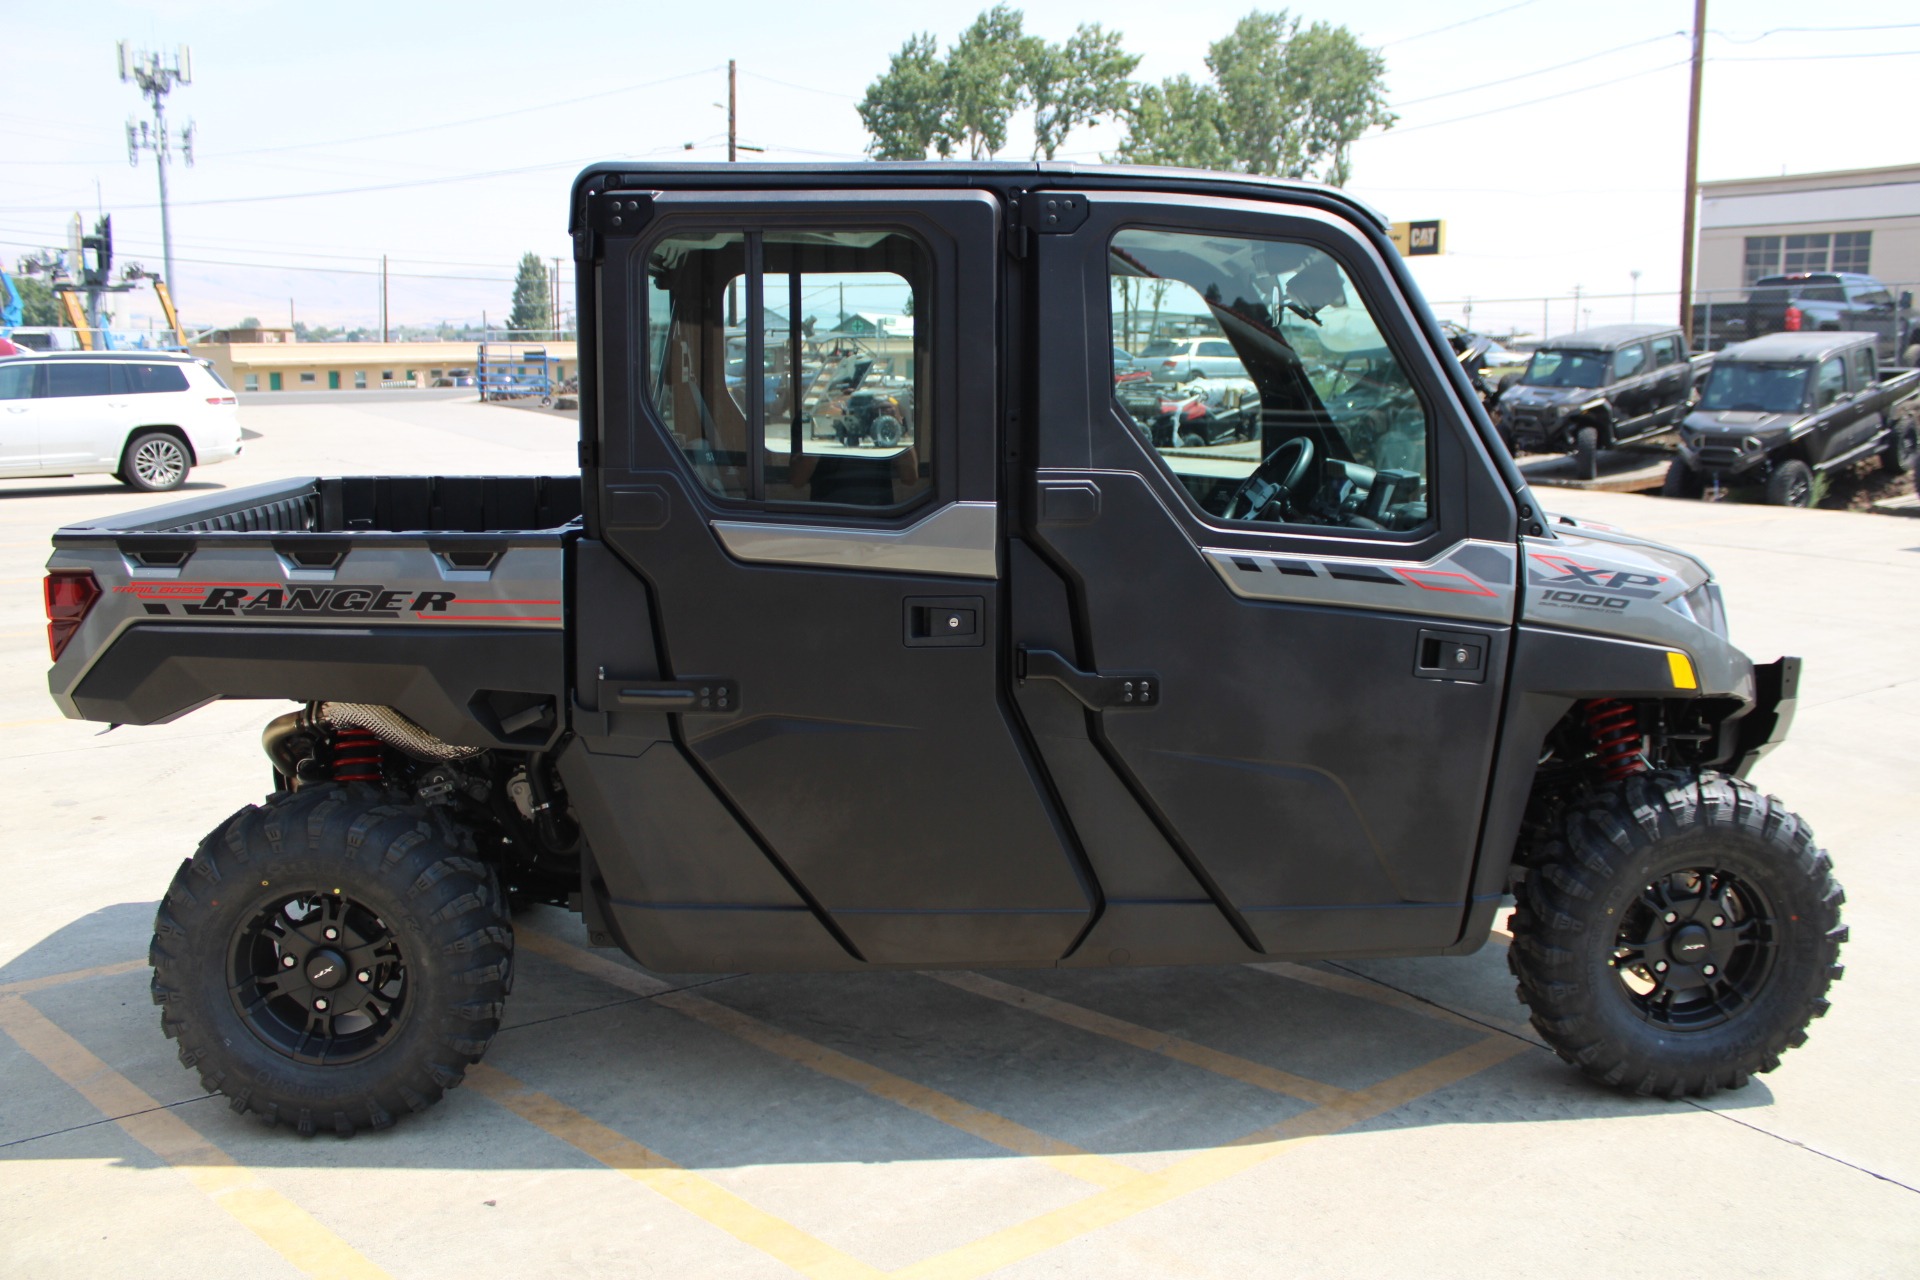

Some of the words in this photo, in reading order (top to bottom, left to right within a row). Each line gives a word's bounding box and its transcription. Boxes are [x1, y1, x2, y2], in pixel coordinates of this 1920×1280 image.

[1411, 227, 1436, 248] CAT
[1550, 564, 1661, 588] XP
[112, 586, 153, 594] TRAIL
[158, 586, 205, 594] BOSS
[201, 587, 456, 612] RANGER
[1541, 589, 1631, 609] 1000
